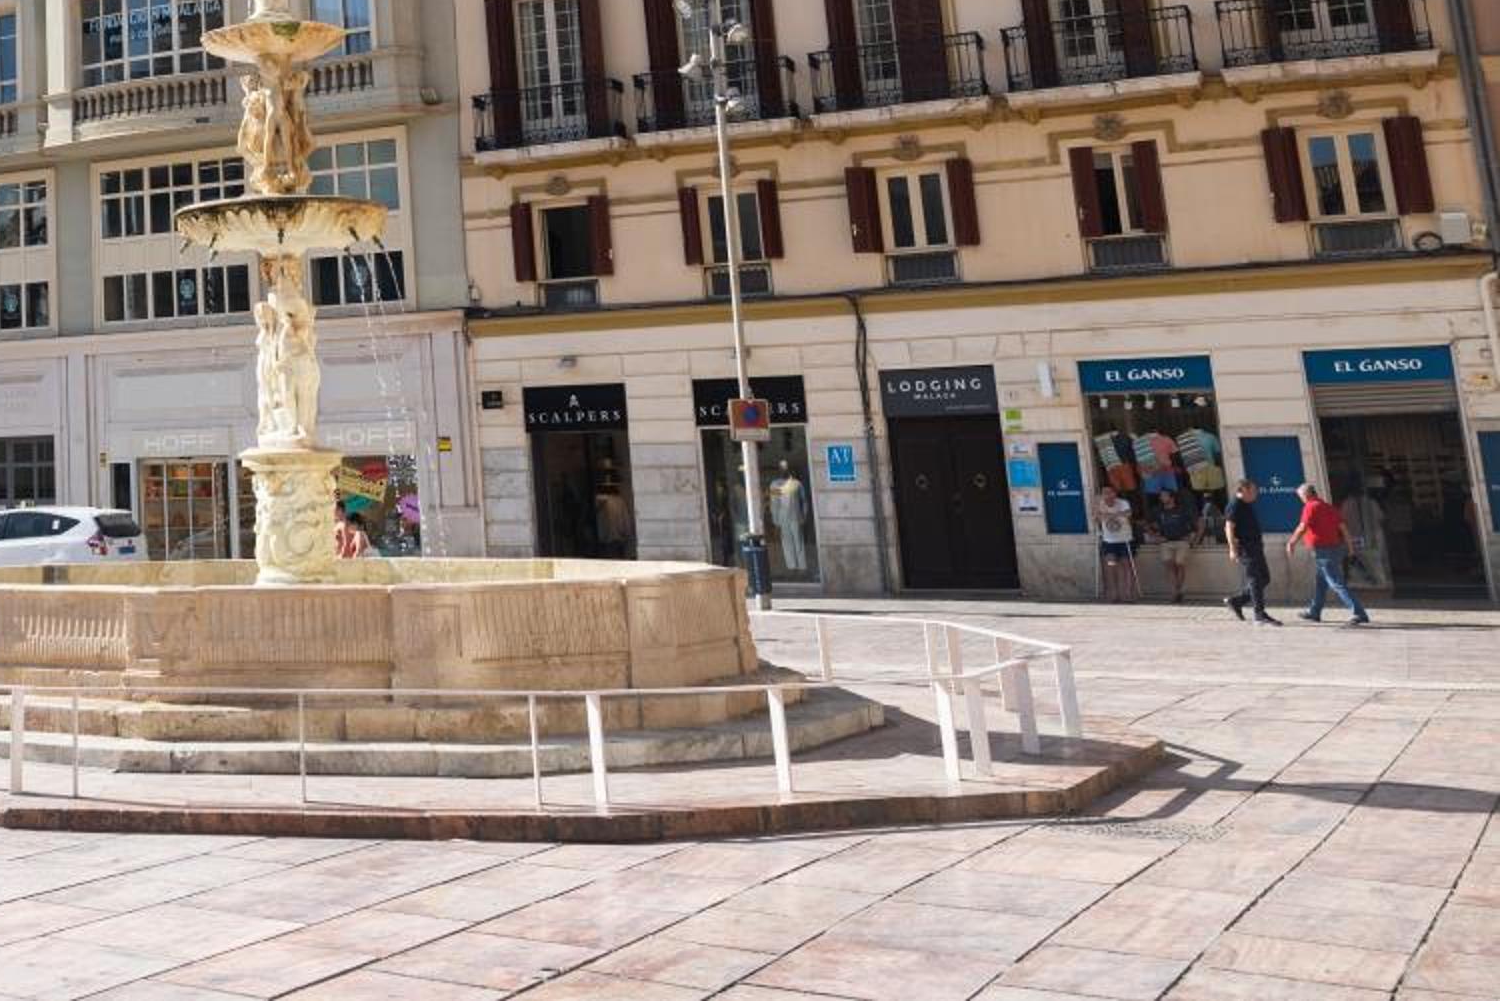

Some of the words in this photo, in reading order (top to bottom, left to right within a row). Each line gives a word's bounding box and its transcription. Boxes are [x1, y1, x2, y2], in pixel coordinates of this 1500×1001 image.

[1332, 360, 1354, 372] EL
[1359, 358, 1422, 372] GANSO
[1105, 370, 1124, 381] EL
[1127, 368, 1184, 380] GANSO
[887, 378, 982, 393] LODGING
[700, 402, 800, 416] SCRS
[528, 410, 621, 424] SCALPERS
